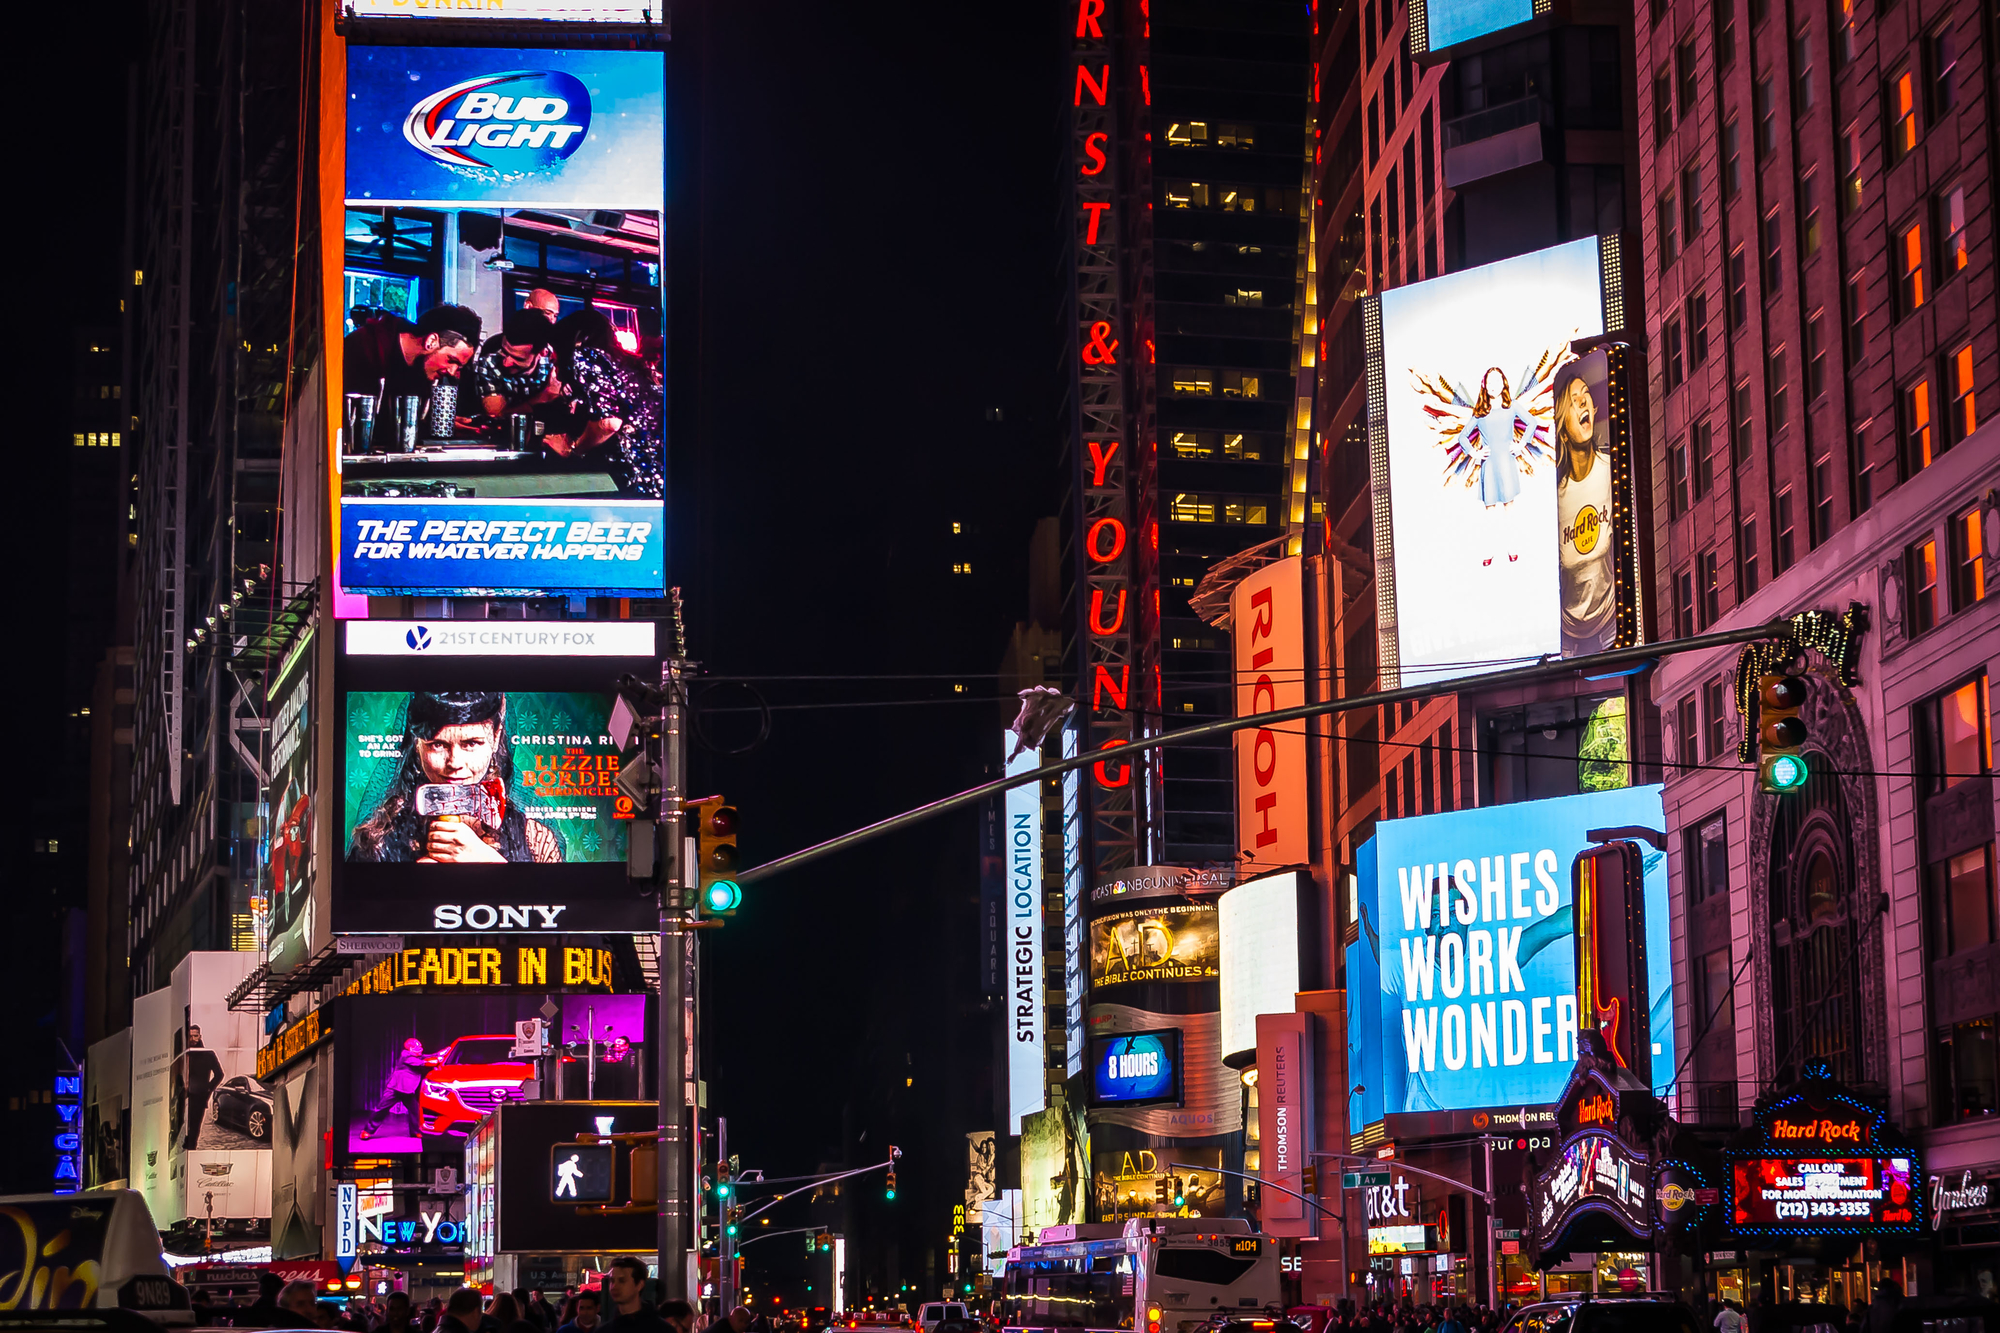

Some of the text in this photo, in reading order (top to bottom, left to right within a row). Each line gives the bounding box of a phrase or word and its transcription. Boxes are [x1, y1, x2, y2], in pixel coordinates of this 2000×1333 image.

[1081, 321, 1119, 365] &
[356, 519, 652, 544] THE PERFECT BEER
[1563, 504, 1609, 545] Hard Rock
[1581, 535, 1593, 547] CAFE
[354, 542, 644, 561] FOR WHATEVER HAPPENS
[1086, 442, 1131, 788] YOUNG
[479, 631, 560, 645] CENTURY
[563, 632, 596, 645] FOX
[1251, 586, 1278, 849] RICOH
[358, 734, 404, 743] SHE'S GOT
[366, 742, 381, 750] AN
[511, 735, 639, 745] CHRISTINA RII
[358, 749, 372, 758] TO
[565, 747, 585, 755] THE
[535, 755, 620, 771] LIZZIE
[534, 787, 620, 797] CHRONICLES
[1398, 849, 1560, 931] WISHES
[434, 904, 567, 929] SONY
[1119, 911, 1134, 919] WAS
[1134, 909, 1153, 917] ONLY
[1153, 907, 1169, 915] THE
[1013, 813, 1035, 1043] STRATEGIC LOCATION
[339, 940, 402, 950] SHERWOOD
[394, 947, 502, 988] LEADER
[518, 947, 547, 986] IN
[1399, 926, 1526, 1003] WORK
[1094, 978, 1104, 989] THE
[1104, 971, 1129, 986] BIBLE
[1129, 966, 1202, 981] CONTINUES
[1108, 1051, 1159, 1080] 8 HOURS
[1275, 1046, 1288, 1172] THOMSON REUTERS
[1579, 1092, 1614, 1124] Hard Rock
[1170, 1113, 1214, 1126] AQUOS
[1773, 1119, 1861, 1143] Hard Rock
[1797, 1163, 1845, 1174] CALL OUR
[196, 1177, 234, 1188] Cadillac
[1775, 1176, 1804, 1187] SALES
[1368, 1176, 1410, 1221] at&t
[1656, 1188, 1671, 1200] Hard
[1672, 1187, 1695, 1201] Rock
[1762, 1189, 1883, 1200] FOR MORE INFORMATION
[1929, 1169, 1988, 1231] Yankees
[71, 1206, 104, 1220] Disney
[1775, 1200, 1870, 1219] (212) 343-3355
[342, 1187, 353, 1254] NYPD
[207, 1270, 258, 1282] nuchas
[136, 1280, 171, 1306] 9N89
